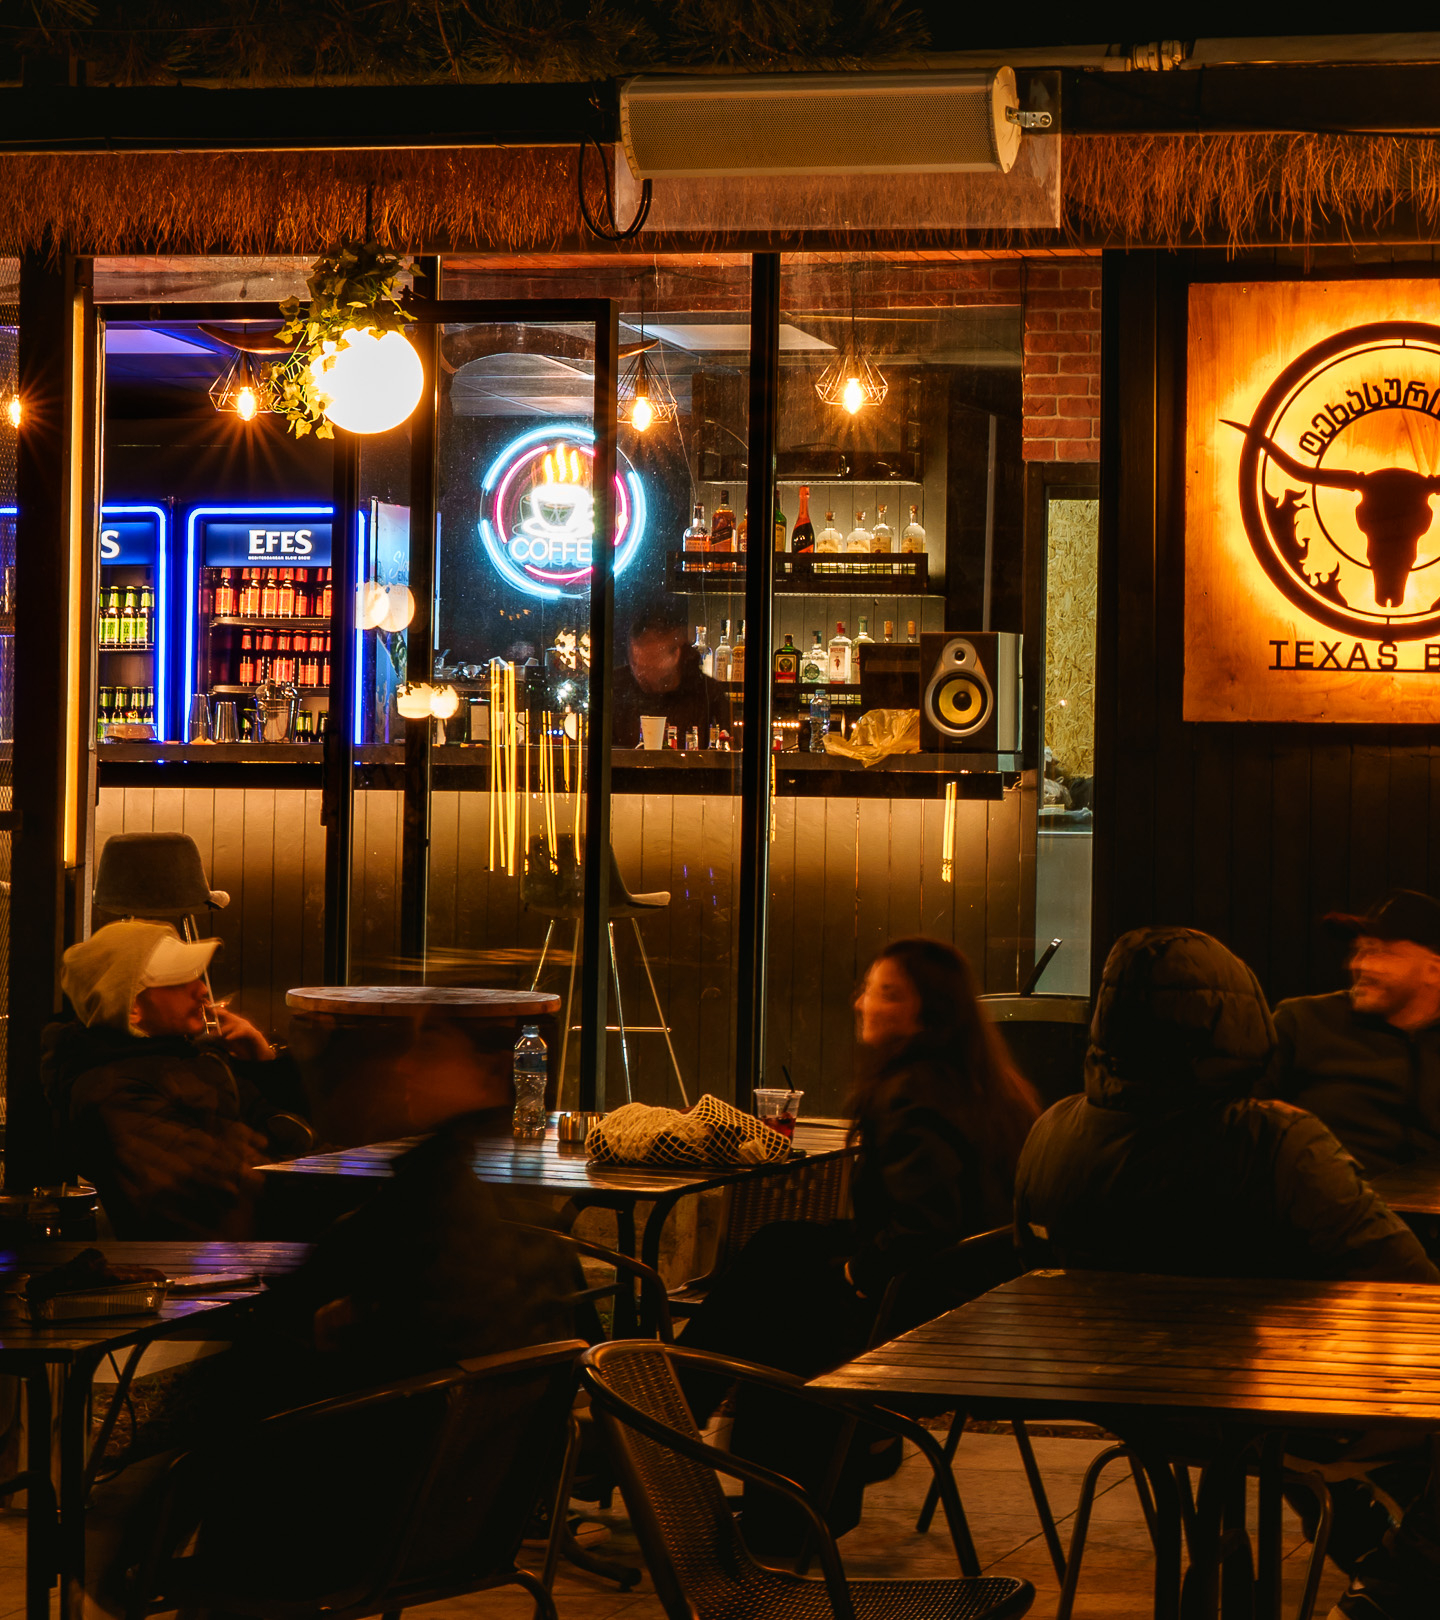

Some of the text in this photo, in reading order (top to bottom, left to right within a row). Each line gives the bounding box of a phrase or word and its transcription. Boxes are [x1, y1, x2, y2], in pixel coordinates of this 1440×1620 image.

[248, 529, 313, 555] EFES
[511, 537, 593, 562] COFFE
[1269, 639, 1399, 670] TEXAS
